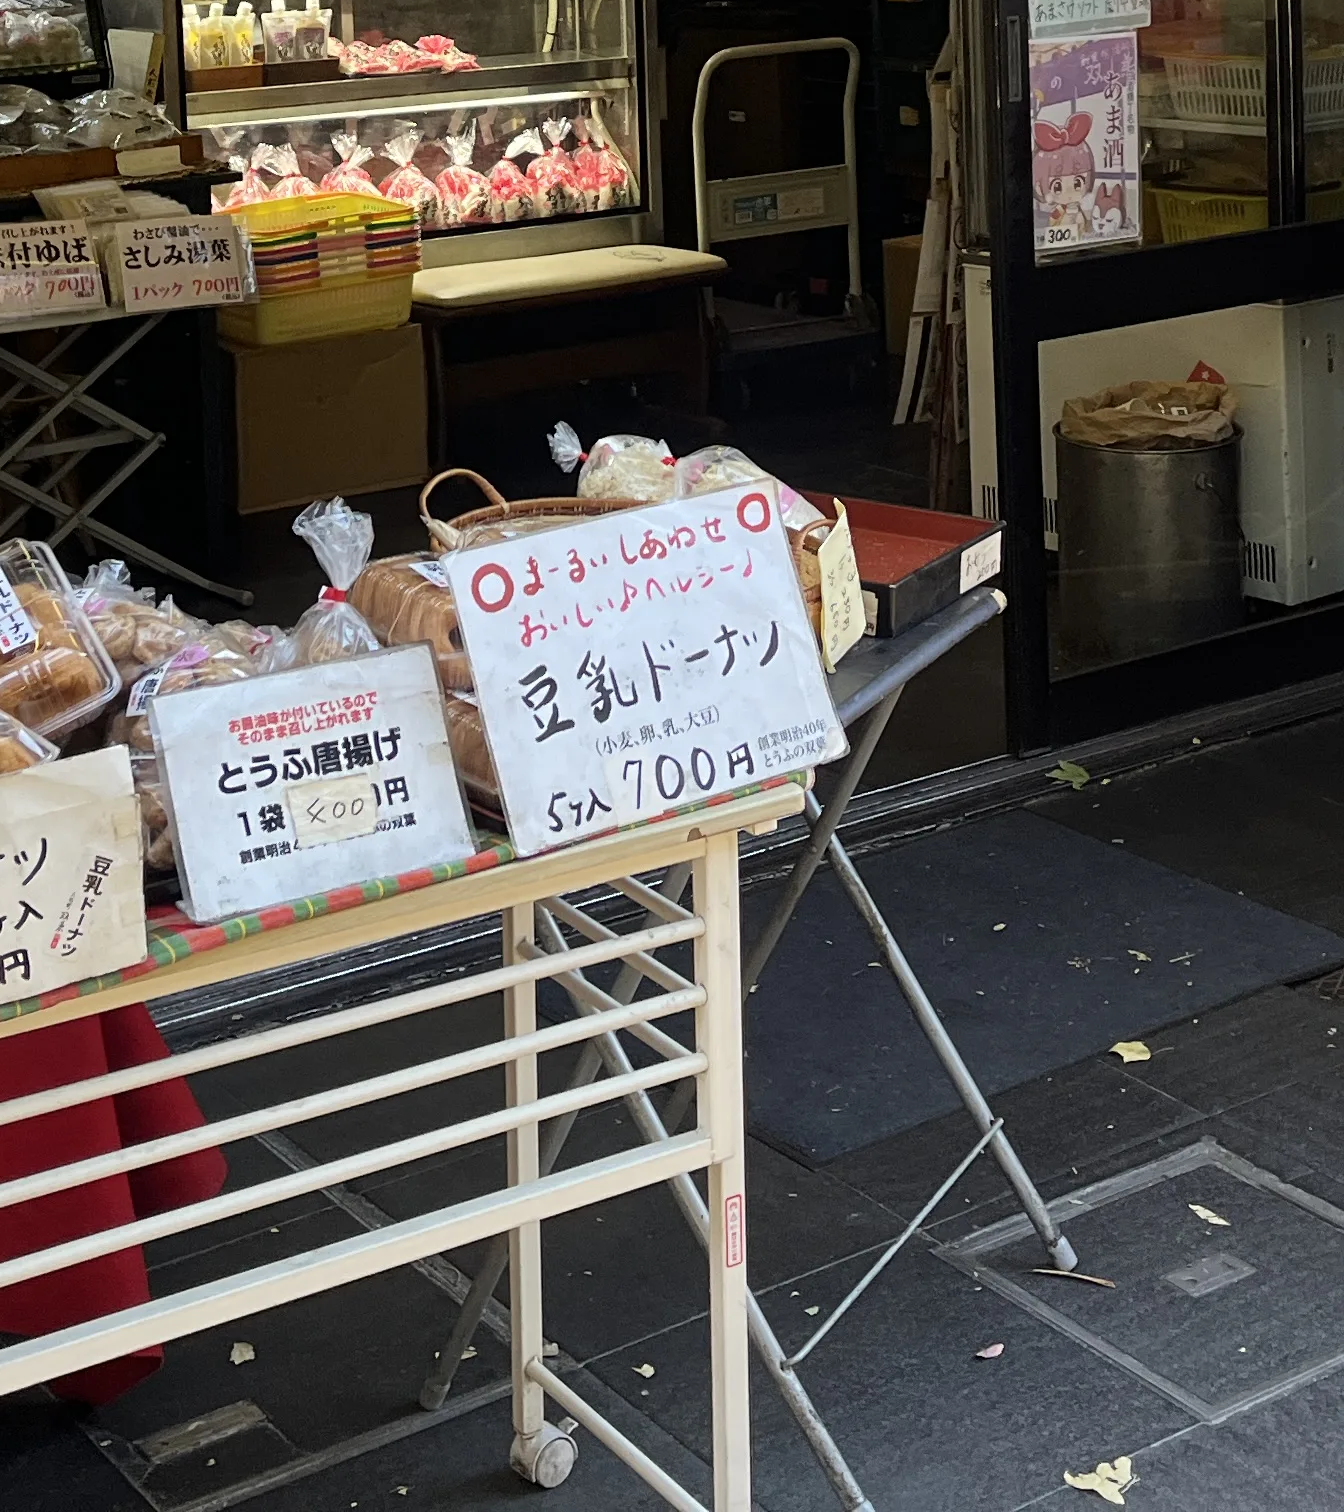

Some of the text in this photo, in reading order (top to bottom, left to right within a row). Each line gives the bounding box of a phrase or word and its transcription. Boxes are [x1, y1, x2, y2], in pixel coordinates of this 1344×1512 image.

[122, 238, 232, 271] さしみ湯葉
[132, 275, 240, 301] 1パック 700円
[518, 620, 780, 744] 豆乳ドーナツ
[228, 691, 378, 734] お醤油味が付いているので
[237, 707, 374, 745] そのまま召し上がれます
[757, 718, 827, 752] 創業明治40年
[763, 738, 828, 769] とうふの双葉
[217, 726, 402, 795] とうふ唐揚げ
[622, 742, 756, 810] 700円
[237, 803, 286, 837] 1袋
[62, 854, 114, 957] 豆乳ドーナツ
